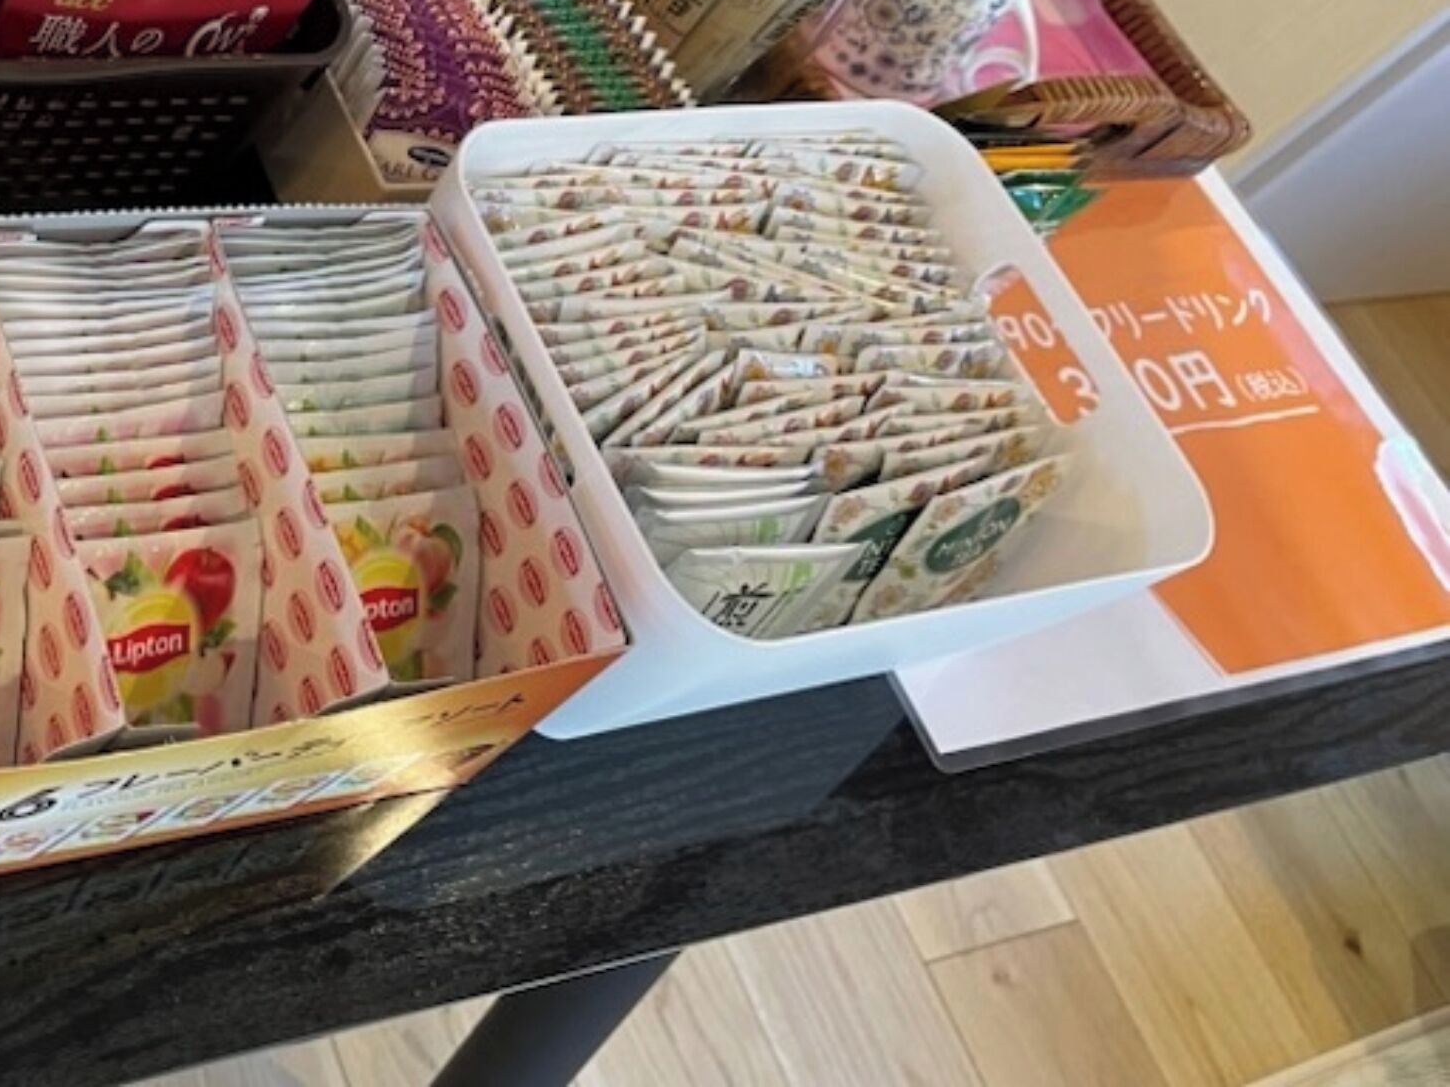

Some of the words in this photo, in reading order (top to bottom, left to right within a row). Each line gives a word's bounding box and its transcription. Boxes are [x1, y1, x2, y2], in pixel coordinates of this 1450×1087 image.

[29, 14, 165, 58] 職人の
[365, 598, 415, 619] pton
[114, 633, 183, 668] Lipton
